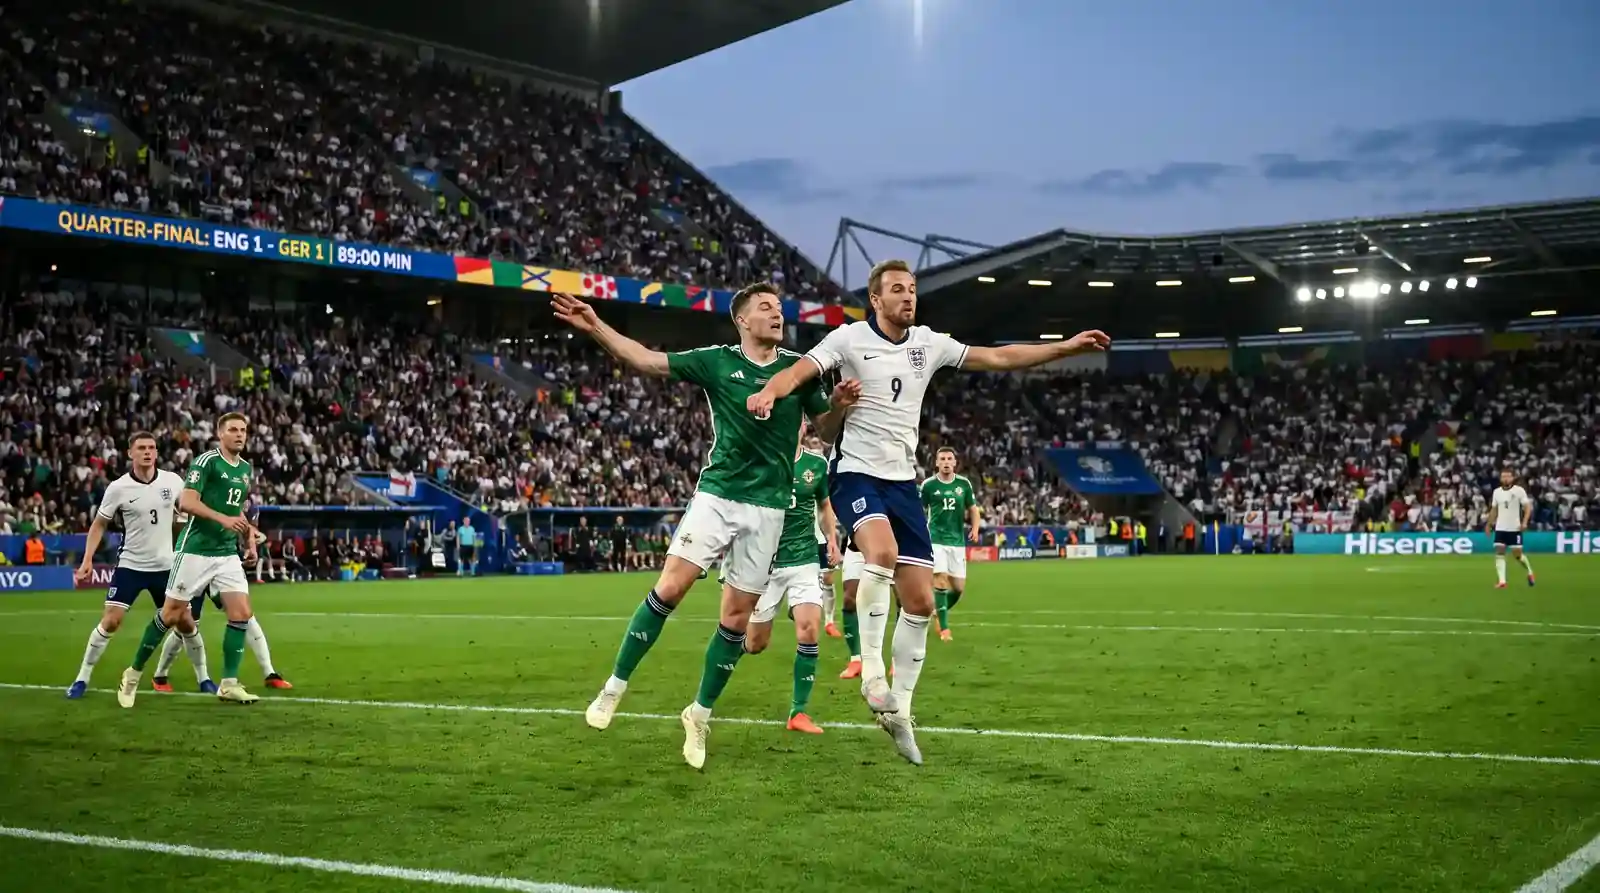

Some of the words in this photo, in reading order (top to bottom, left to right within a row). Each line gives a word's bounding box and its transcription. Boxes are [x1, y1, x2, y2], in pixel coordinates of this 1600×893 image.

[58, 210, 210, 247] QUARTER-FINAL:
[213, 229, 249, 251] ENG
[253, 235, 263, 253] 1
[279, 238, 311, 259] GER
[315, 243, 325, 260] 1
[337, 245, 381, 267] 89:00
[383, 251, 412, 271] MIN
[891, 377, 903, 403] 9
[942, 497, 956, 510] 12
[149, 508, 158, 525] 3
[1344, 533, 1473, 555] Hisense
